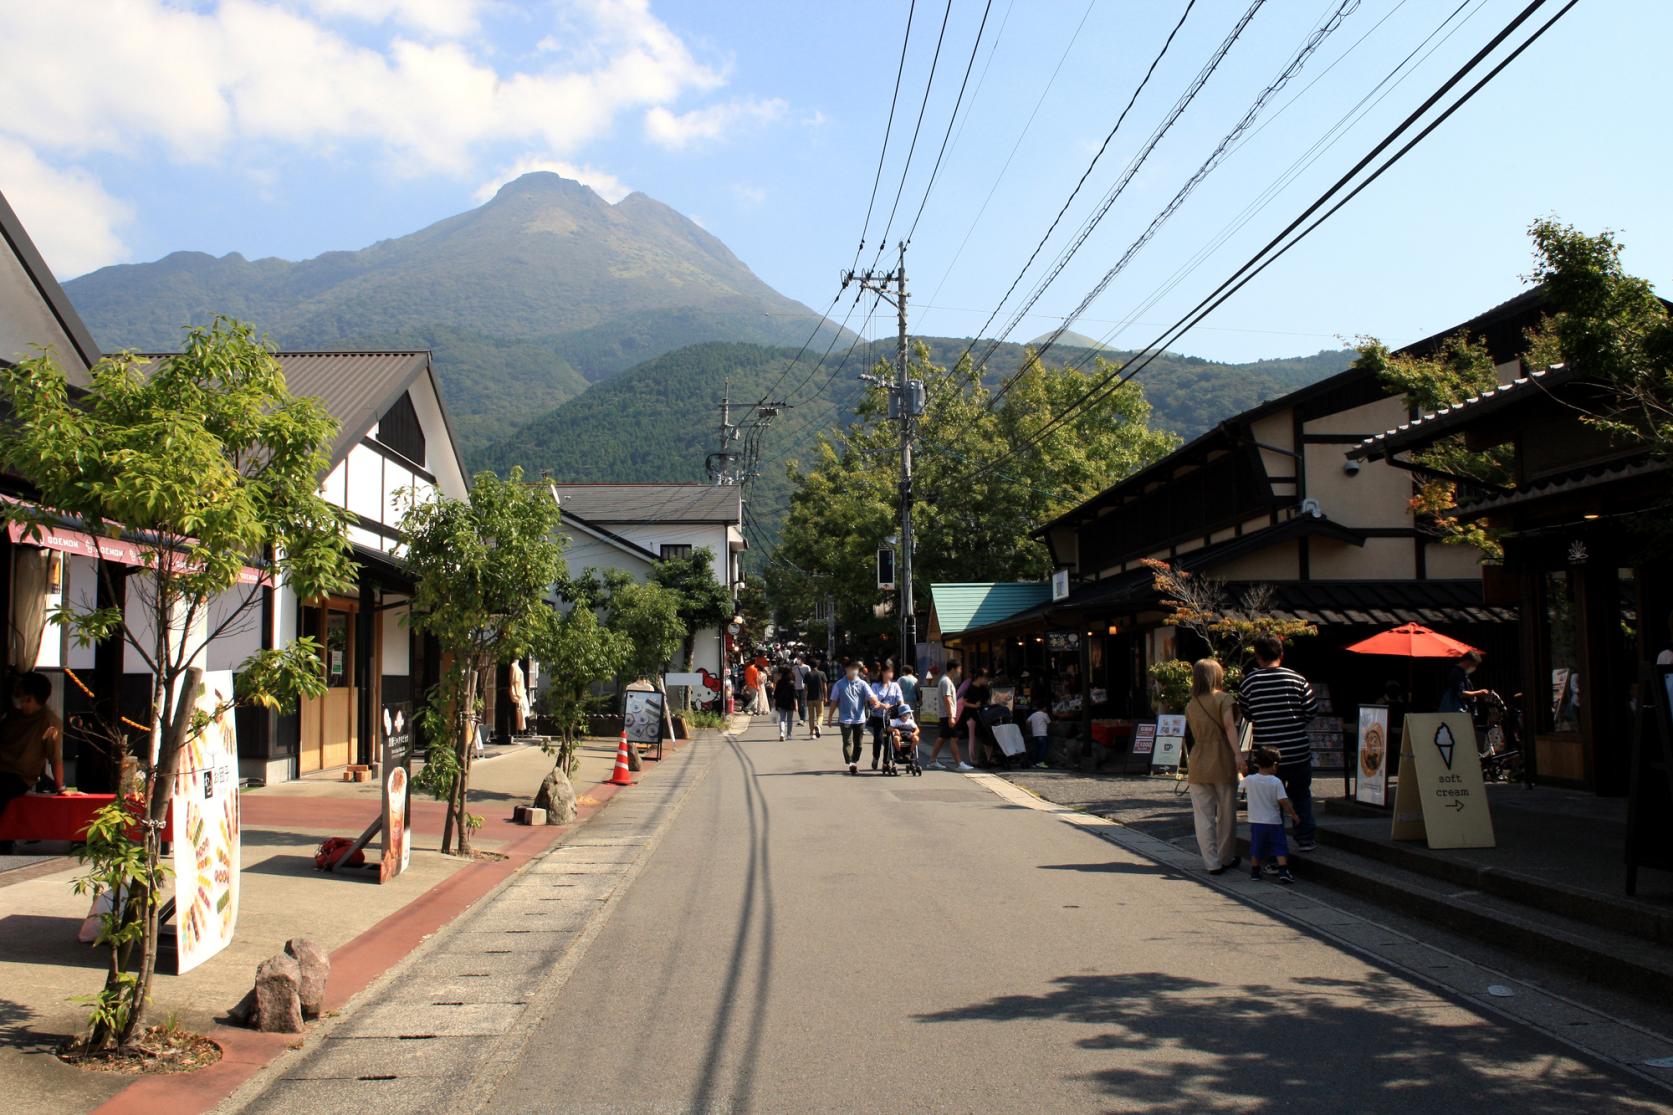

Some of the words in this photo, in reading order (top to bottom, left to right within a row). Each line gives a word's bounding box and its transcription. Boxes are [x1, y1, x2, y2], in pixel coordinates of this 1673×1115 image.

[48, 536, 79, 548] GOEMON
[95, 546, 124, 557] OEMON
[1439, 774, 1463, 783] soft
[1436, 789, 1470, 797] cream
